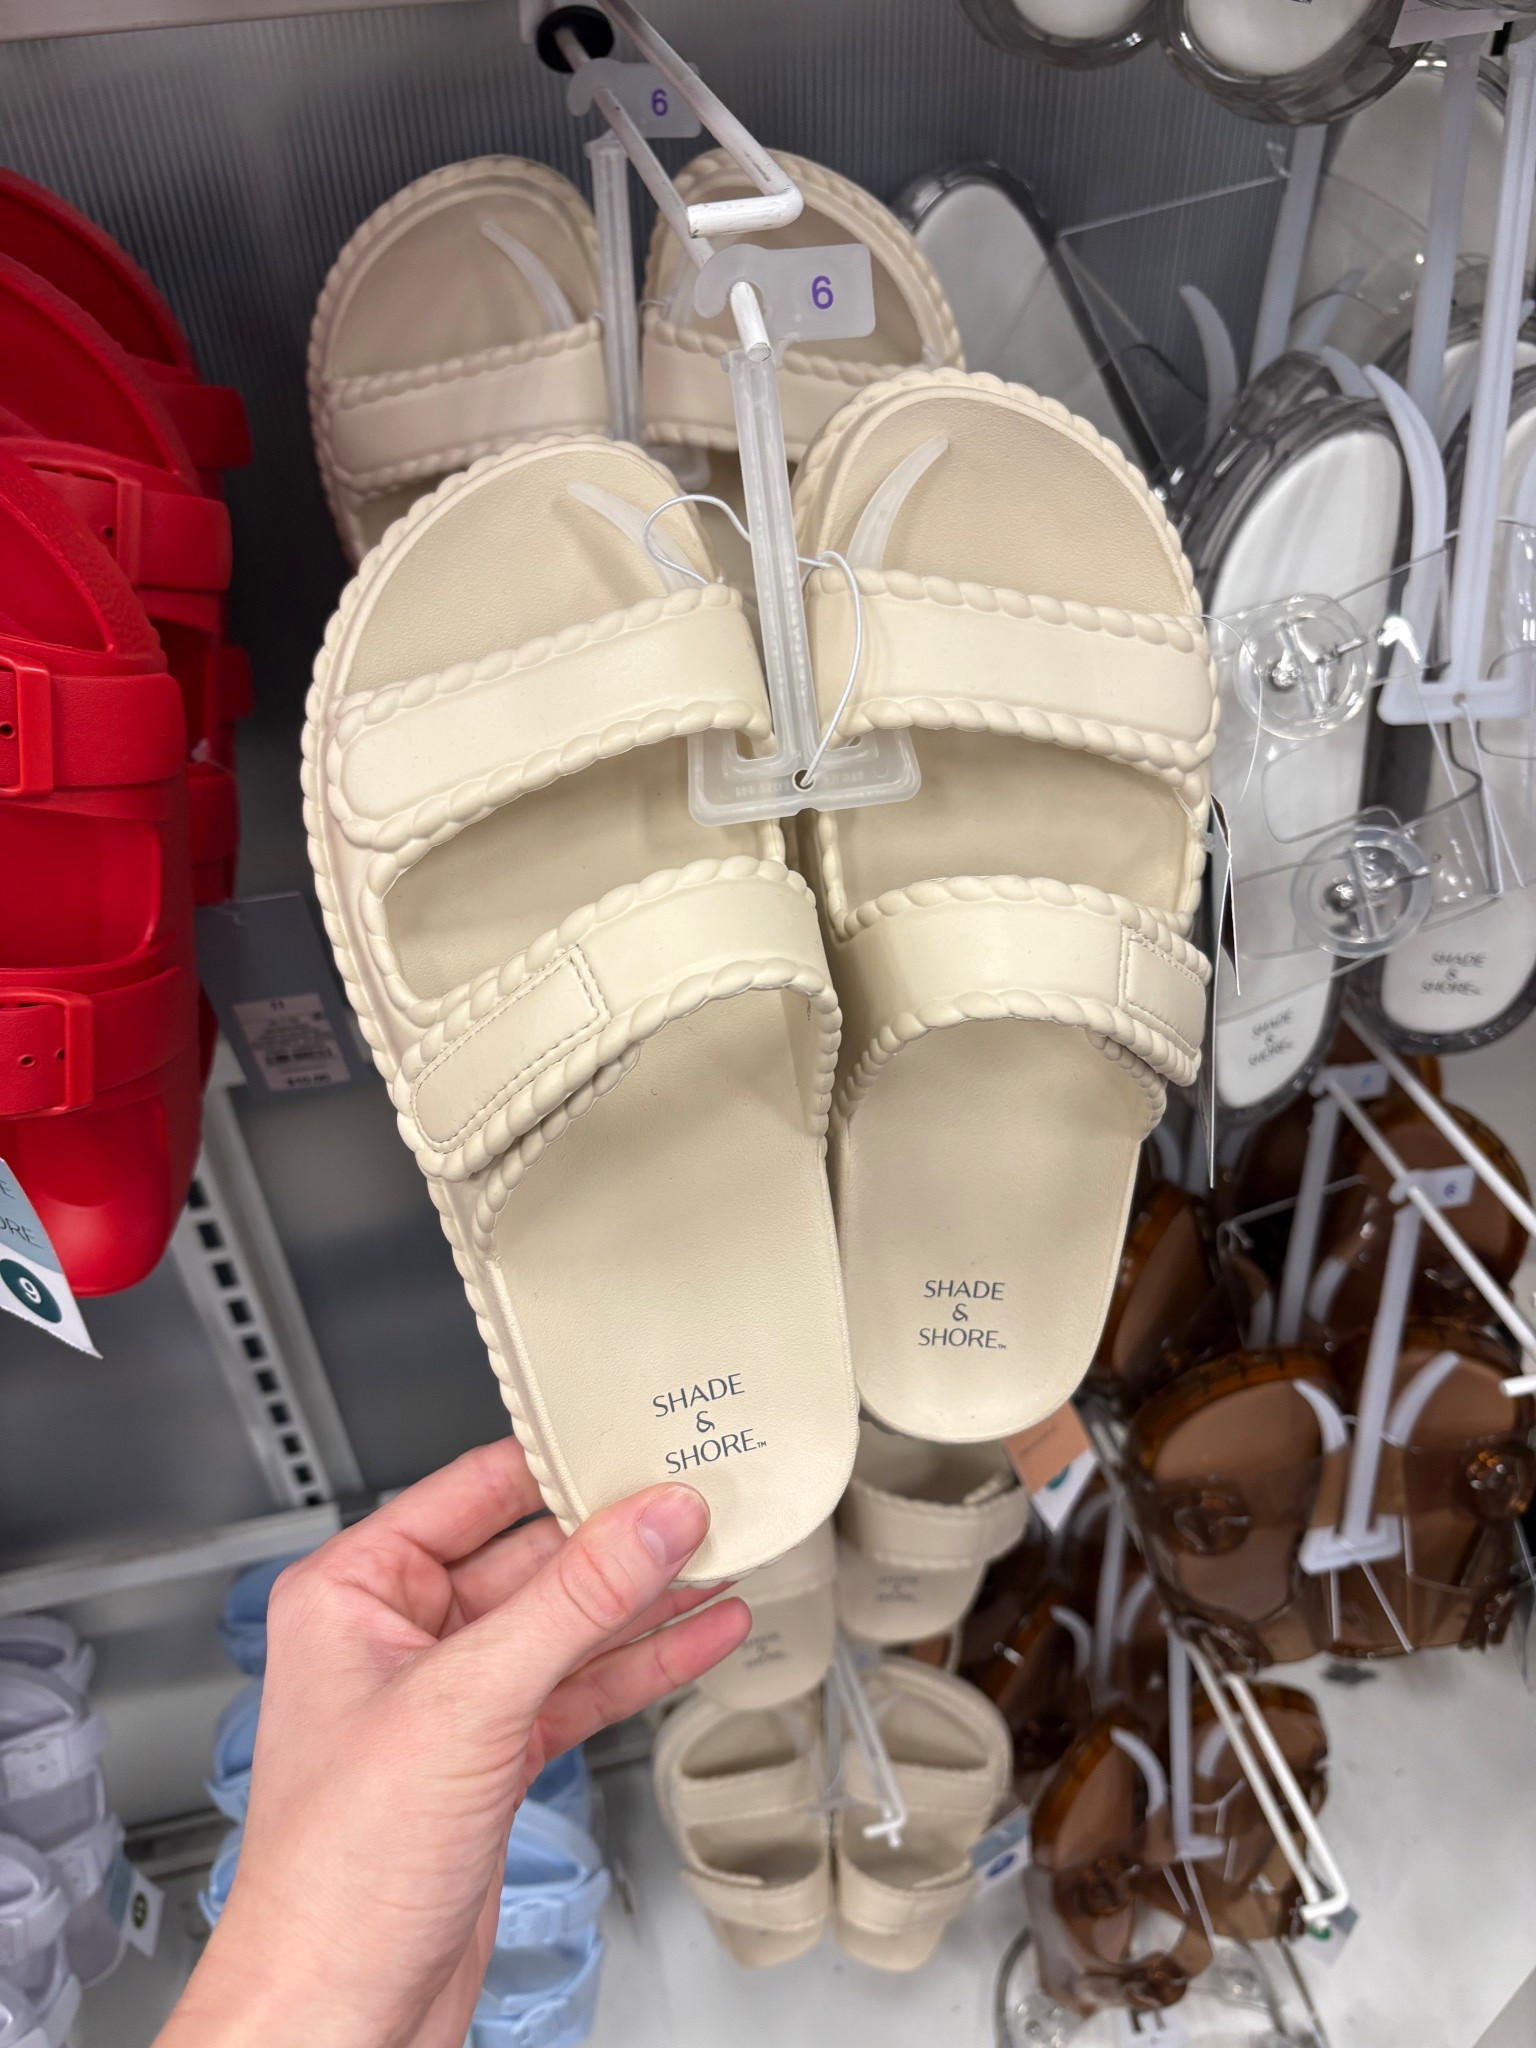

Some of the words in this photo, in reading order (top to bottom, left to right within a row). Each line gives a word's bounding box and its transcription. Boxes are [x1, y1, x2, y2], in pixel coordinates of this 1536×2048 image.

[651, 88, 669, 117] 6
[811, 275, 834, 310] 6
[923, 1279, 1006, 1301] SHADE
[952, 1303, 969, 1323] &
[652, 1372, 746, 1418] SHADE
[696, 1410, 716, 1433] &
